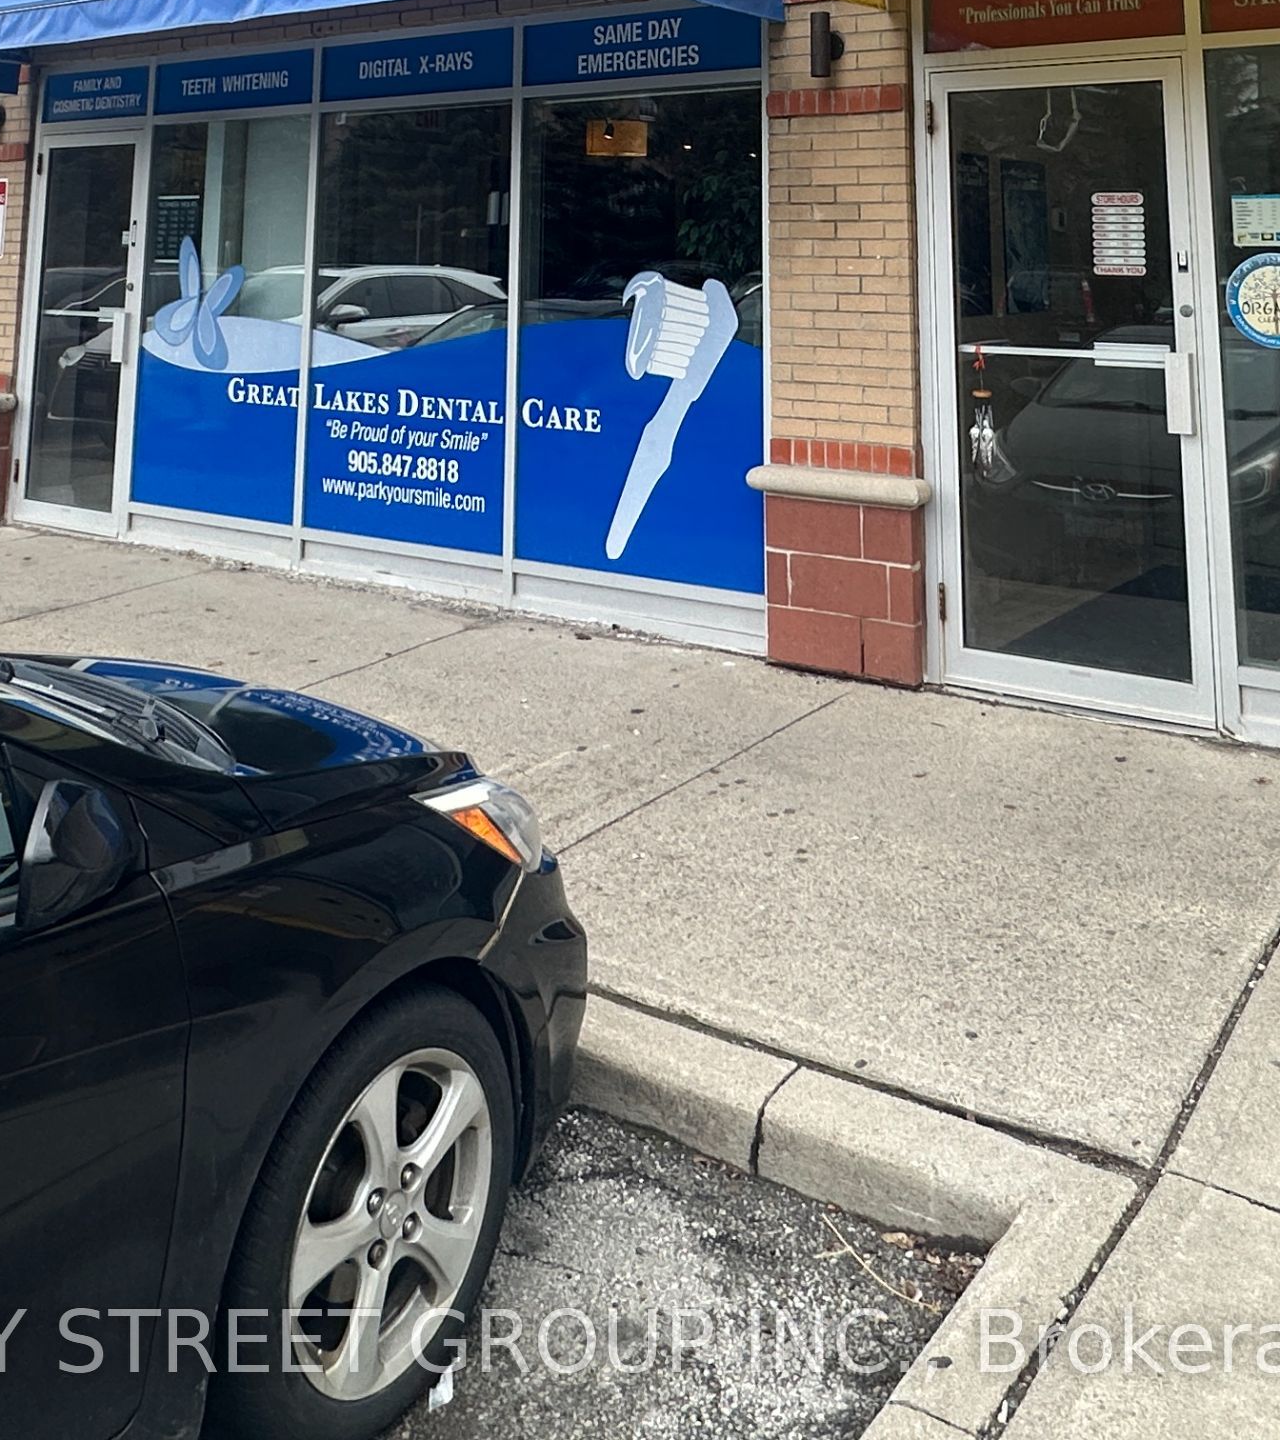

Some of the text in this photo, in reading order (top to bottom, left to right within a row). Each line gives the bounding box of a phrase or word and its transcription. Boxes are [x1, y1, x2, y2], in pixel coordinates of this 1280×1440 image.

[593, 17, 682, 46] SAME DAY
[358, 51, 473, 80] DIGITAL X-RAYS
[577, 44, 700, 75] EMERGENCIES
[73, 76, 122, 93] FAMILY AND
[181, 70, 289, 97] TEETH WHITENING
[53, 93, 141, 114] COSMETIC DENTISTRY
[227, 377, 602, 433] GREAT LAKES DENTAL CARE
[350, 421, 388, 443] Proud
[391, 424, 405, 445] of
[406, 429, 436, 450] your
[347, 449, 459, 483] 905.847.8818
[322, 476, 486, 513] www.parkyoursmile.com
